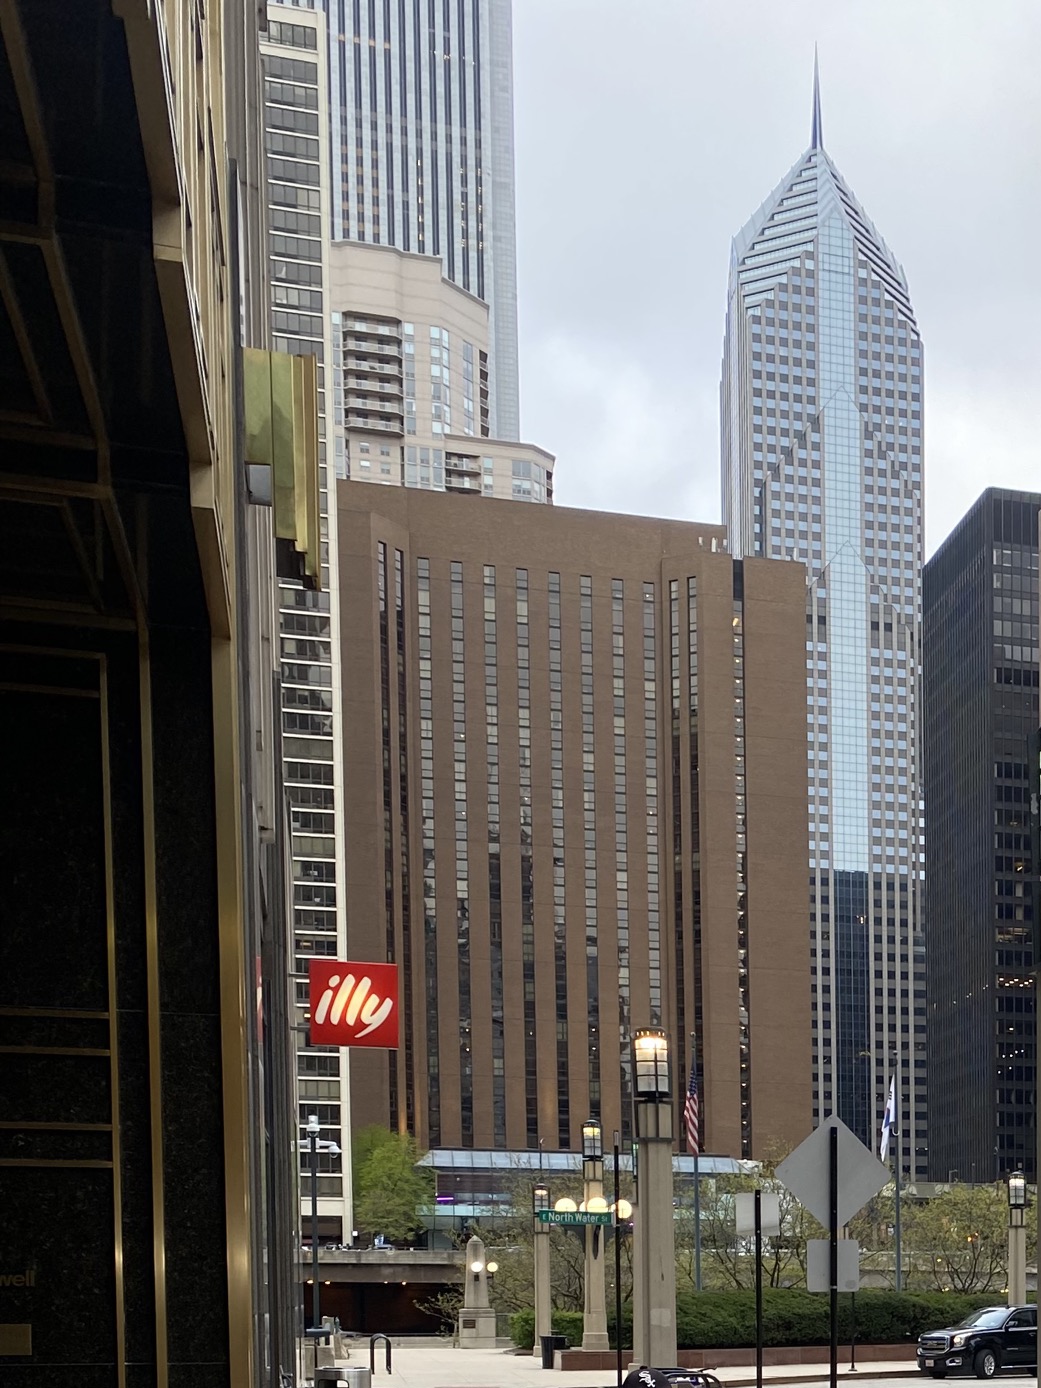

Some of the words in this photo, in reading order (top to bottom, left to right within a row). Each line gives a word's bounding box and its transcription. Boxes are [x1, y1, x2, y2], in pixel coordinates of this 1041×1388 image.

[315, 973, 393, 1038] illy
[548, 1212, 574, 1222] North
[575, 1212, 599, 1223] Water
